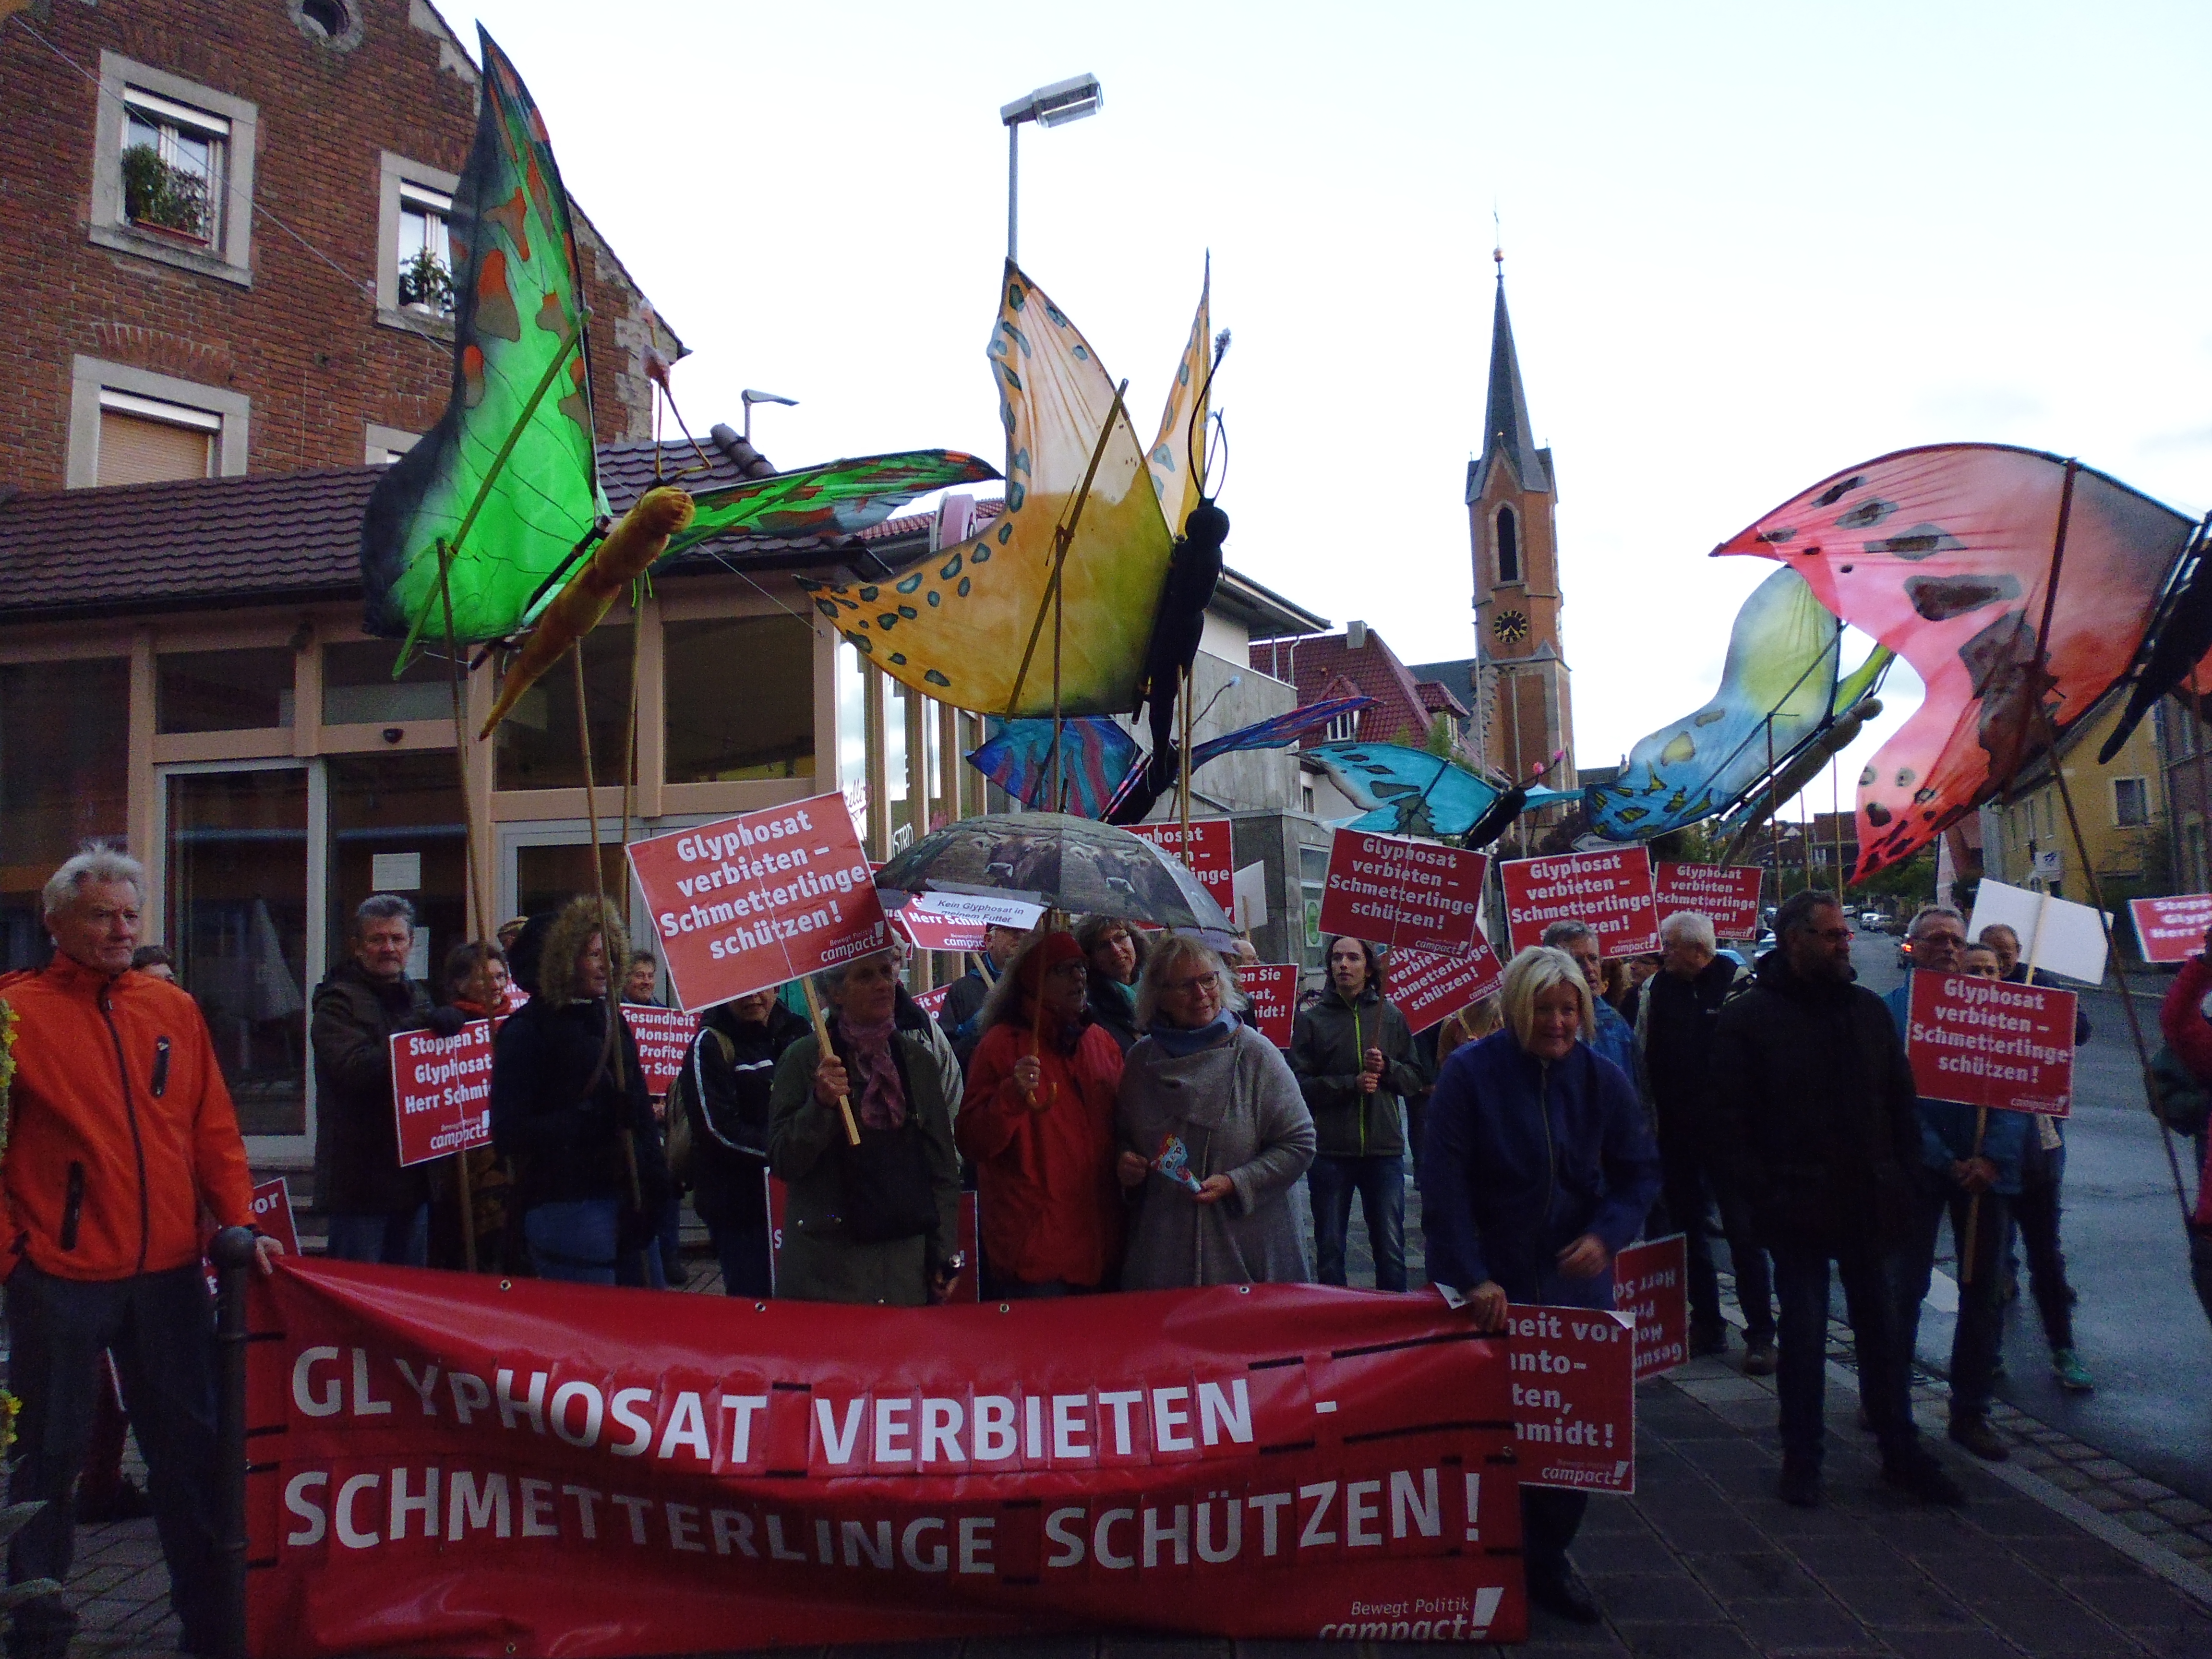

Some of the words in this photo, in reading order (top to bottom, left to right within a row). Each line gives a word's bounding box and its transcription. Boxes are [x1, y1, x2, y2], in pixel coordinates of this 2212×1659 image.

[677, 810, 812, 862] Glyphosat
[1363, 838, 1457, 869] Glyphosat
[677, 848, 808, 897] verbieten
[1351, 860, 1442, 887] verbieten
[1530, 854, 1622, 880] Glyphosat
[1677, 866, 1742, 880] Glyphosat
[1329, 874, 1474, 915] Schmetterlinge
[1527, 877, 1614, 901] verbieten
[1670, 880, 1733, 894] verbieten
[660, 865, 866, 937] Schmetterlinge
[938, 900, 961, 909] Kein
[962, 902, 1012, 915] Glyphosat
[1014, 907, 1024, 915] in
[1512, 892, 1651, 925] Schmetterlinge
[1657, 892, 1756, 911] Schmetterlinge
[909, 912, 942, 925] Herr
[941, 909, 980, 919] meinem
[982, 913, 1012, 923] Futter
[830, 934, 851, 946] Bewegt
[944, 938, 986, 948] campac
[1259, 969, 1281, 981] Sie
[1389, 953, 1440, 984] verbiet
[1944, 978, 2045, 1010] Glyphosat
[623, 1009, 695, 1027] Gesundheit
[1934, 1006, 2032, 1033] verbieten
[409, 1034, 471, 1057] Stoppen
[475, 1024, 490, 1045] Si
[639, 1044, 686, 1059] Profite
[1911, 1022, 2068, 1065] Schmetterlinge
[405, 1094, 440, 1114] Herr
[444, 1078, 491, 1106] Schmi
[1572, 1322, 1619, 1343] vor
[291, 1346, 767, 1464] GLYPHOSAT
[815, 1378, 1253, 1466] VERBIETEN
[1541, 1460, 1629, 1486] campact!
[284, 1467, 996, 1574] SCHMETTERLINGE
[1351, 1600, 1408, 1618] Bewegt
[1415, 1597, 1469, 1613] Politik
